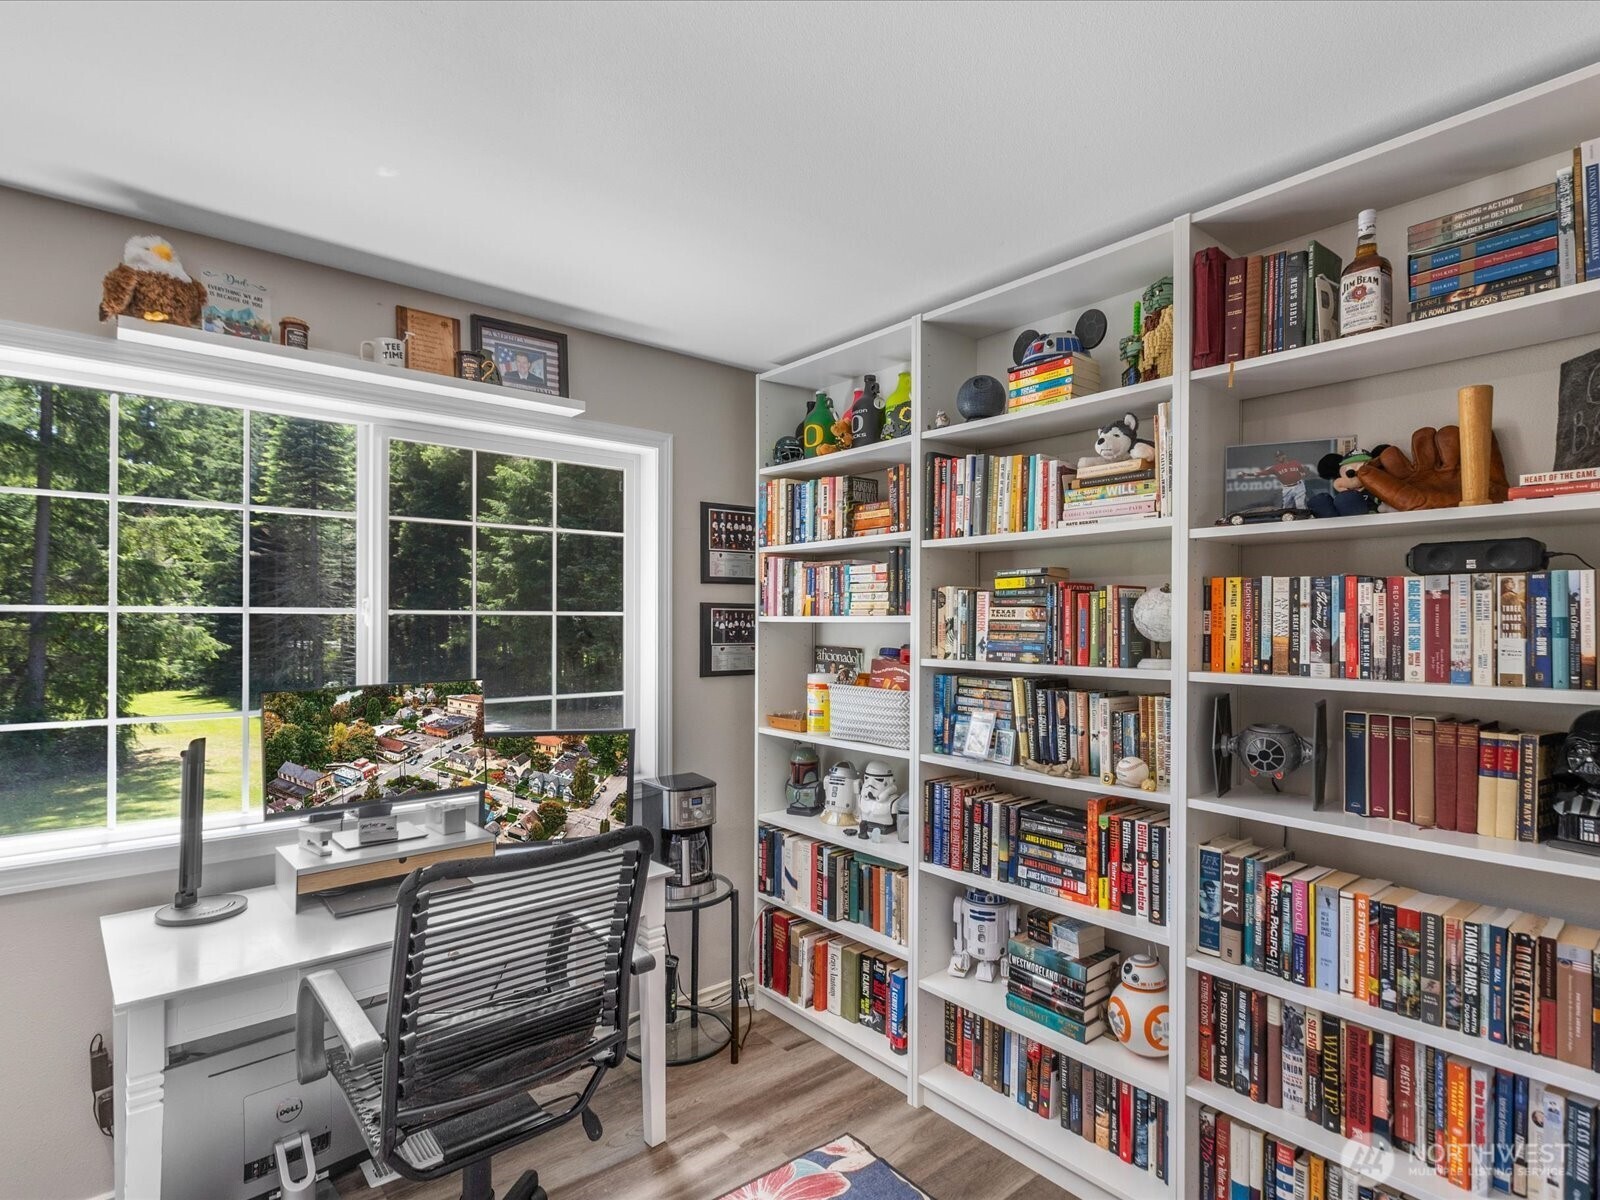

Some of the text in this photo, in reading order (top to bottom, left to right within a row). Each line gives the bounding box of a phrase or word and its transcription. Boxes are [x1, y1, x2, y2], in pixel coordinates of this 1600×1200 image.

[1588, 165, 1597, 193] LINCOLN
[1454, 197, 1514, 220] MISSING ACTION
[1590, 194, 1598, 211] AND
[1455, 219, 1503, 238] SOLDIER BOYS
[1591, 224, 1600, 262] ADMIRALS
[1433, 253, 1460, 264] TOLKIEN
[1432, 267, 1458, 279] TOLKIEN
[1507, 275, 1533, 285] TOLKIEN
[208, 283, 241, 297] EVERYTHING
[1342, 276, 1379, 296] JIM BEAM
[1431, 281, 1458, 292] TOLKIEN
[216, 293, 241, 303] BECAUSE
[251, 301, 263, 309] YOU
[1290, 276, 1298, 326] MEN'S BIBLE
[1419, 295, 1498, 320] JK ROWLING BEASTS
[382, 351, 403, 360] TIME
[384, 342, 401, 351] TEE
[975, 474, 983, 498] TEAM
[1525, 475, 1546, 483] HEART
[1576, 470, 1597, 478] GAME
[1106, 483, 1136, 496] WILL
[977, 594, 986, 632] DUNKIRK
[1275, 598, 1281, 609] AT
[1282, 598, 1288, 609] AN
[1408, 580, 1420, 650] EAGLE AGAINST THE SUN
[1229, 614, 1237, 641] CHERNOBYL
[1312, 591, 1328, 657] Thomas Jefferson
[1536, 597, 1547, 655] SCORPION DOWN
[1570, 602, 1580, 639] Tim O'Brien
[1362, 627, 1370, 642] JOHN
[816, 648, 857, 663] aficionado
[1037, 690, 1047, 737] JOHN GRISHAM
[1058, 725, 1066, 738] JOHN
[1525, 743, 1533, 762] THIS
[1525, 766, 1532, 775] IS
[953, 788, 961, 806] ROSES
[952, 819, 960, 830] RED
[1523, 803, 1532, 827] NAVY
[1025, 835, 1063, 850] JAMES PATTERSON
[1110, 821, 1119, 848] Griffin
[1123, 821, 1132, 849] Griffin
[951, 836, 960, 866] PATTERSON
[1202, 854, 1219, 866] JFK
[1024, 858, 1062, 874] JAMES PATTERSON
[1137, 824, 1147, 911] Griffin Final Justice
[1027, 871, 1062, 885] JAMES PATTERSON
[1295, 889, 1303, 932] HARD CALL
[1358, 898, 1365, 910] 12
[1270, 881, 1280, 958] WAR PACIFIC
[1427, 916, 1435, 948] CRUCIBLE
[1427, 950, 1433, 959] OF
[1464, 925, 1478, 996] TAKING PARIS
[1011, 955, 1058, 982] WESTMORELAND
[830, 974, 838, 997] Anatomy
[862, 973, 870, 998] CLANCY
[1514, 945, 1532, 1019] DODGE CITY
[1350, 1031, 1358, 1087] ATOMIC BOMB
[1324, 1035, 1339, 1115] WHAT IF?
[1400, 1065, 1411, 1096] CHESTY
[1121, 1083, 1129, 1095] RED
[280, 1104, 300, 1116] DELL
[1200, 1137, 1215, 1165] 1776
[1576, 1110, 1590, 1184] THE CSS VIRGINIA
